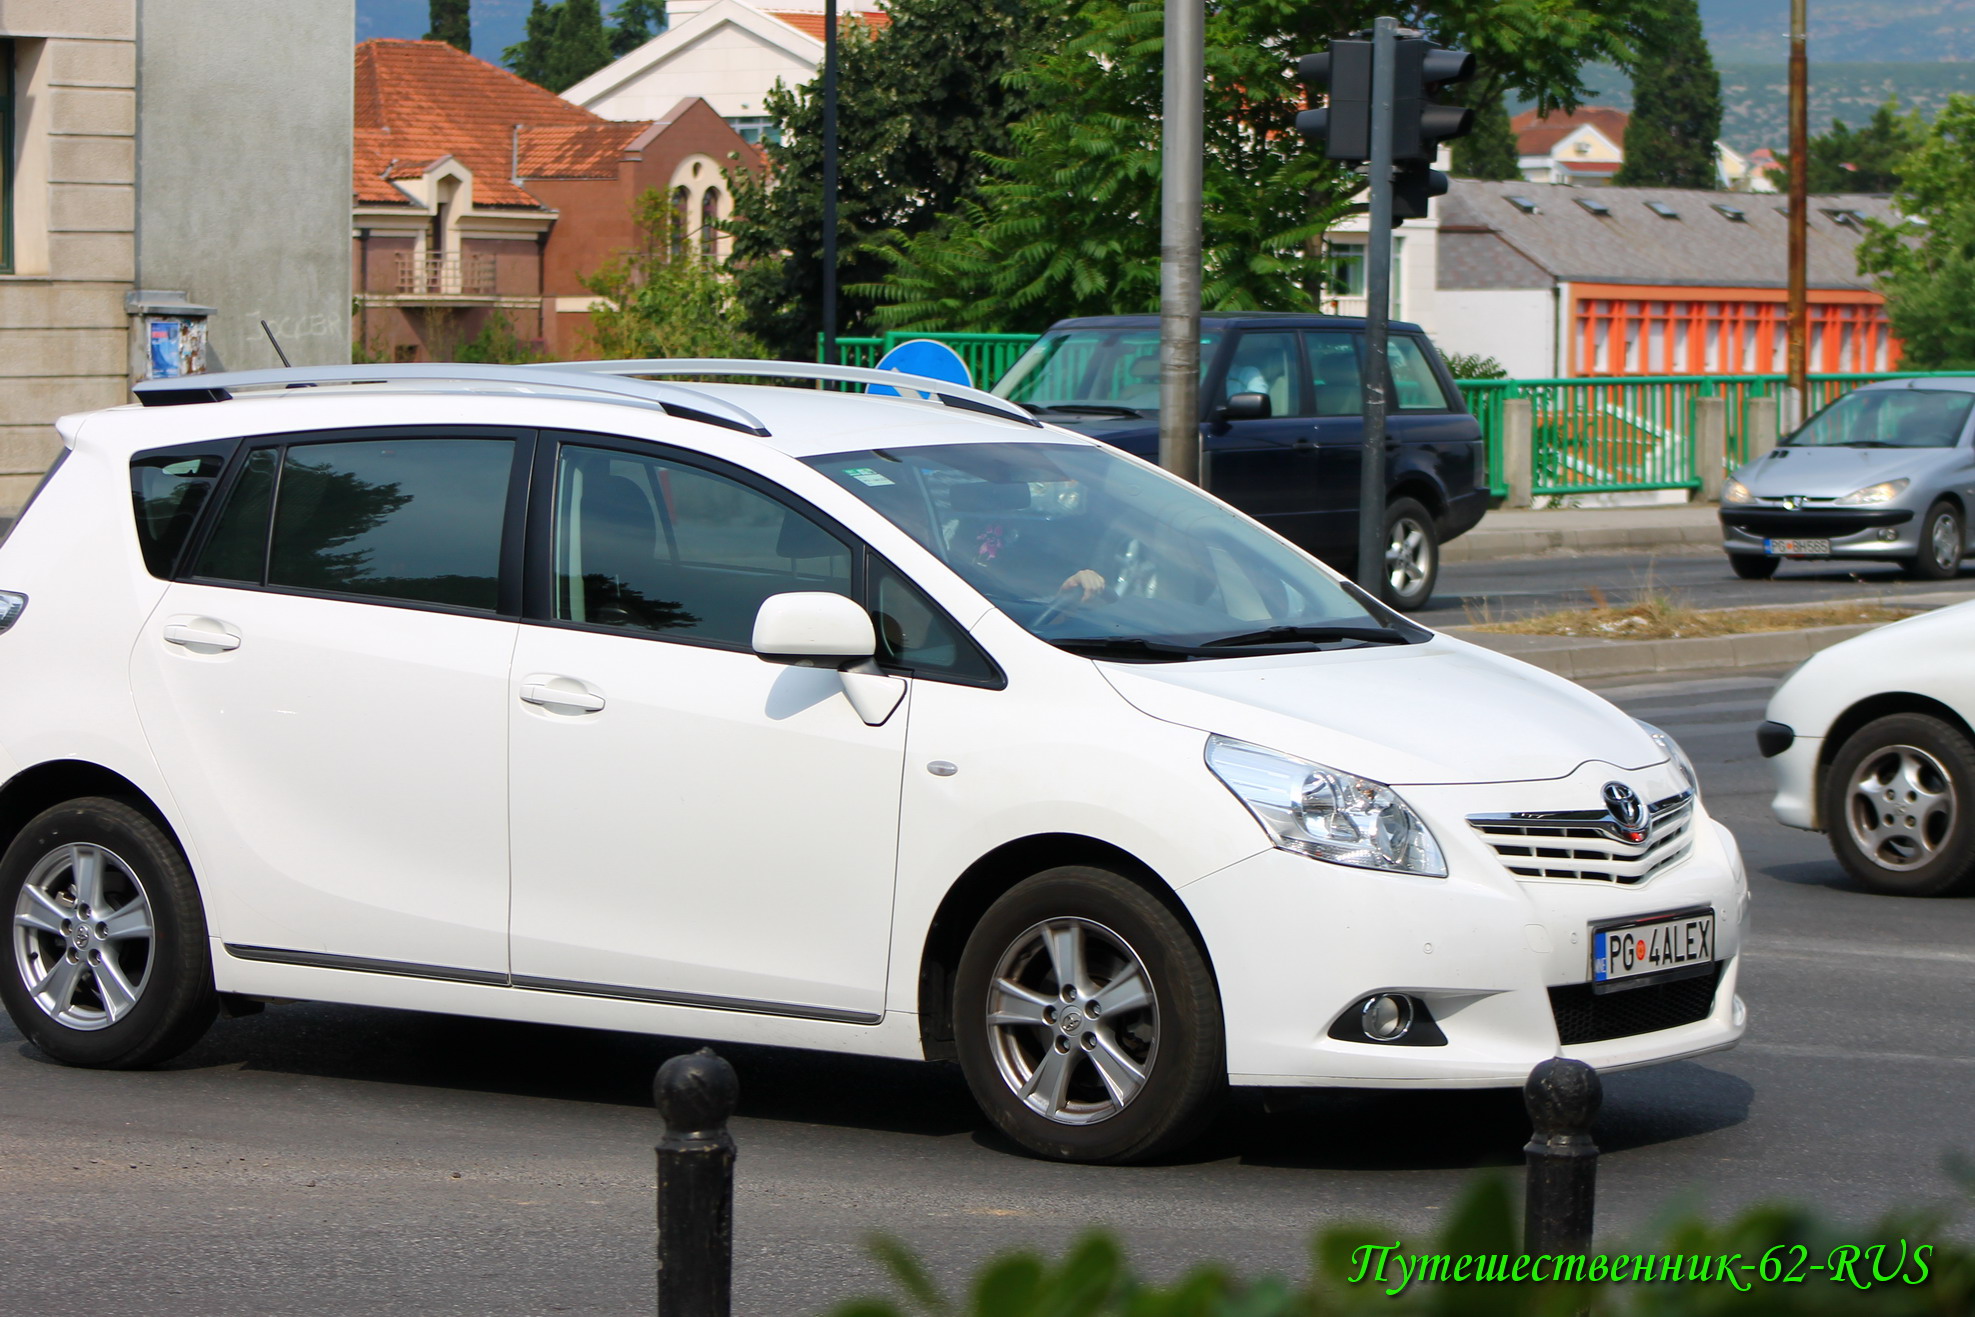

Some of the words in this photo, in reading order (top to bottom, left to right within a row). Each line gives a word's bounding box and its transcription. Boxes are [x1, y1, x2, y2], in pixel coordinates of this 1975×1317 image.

[1771, 540, 1786, 553] PG
[1609, 933, 1634, 974] PG
[1649, 919, 1710, 967] 4ALEX
